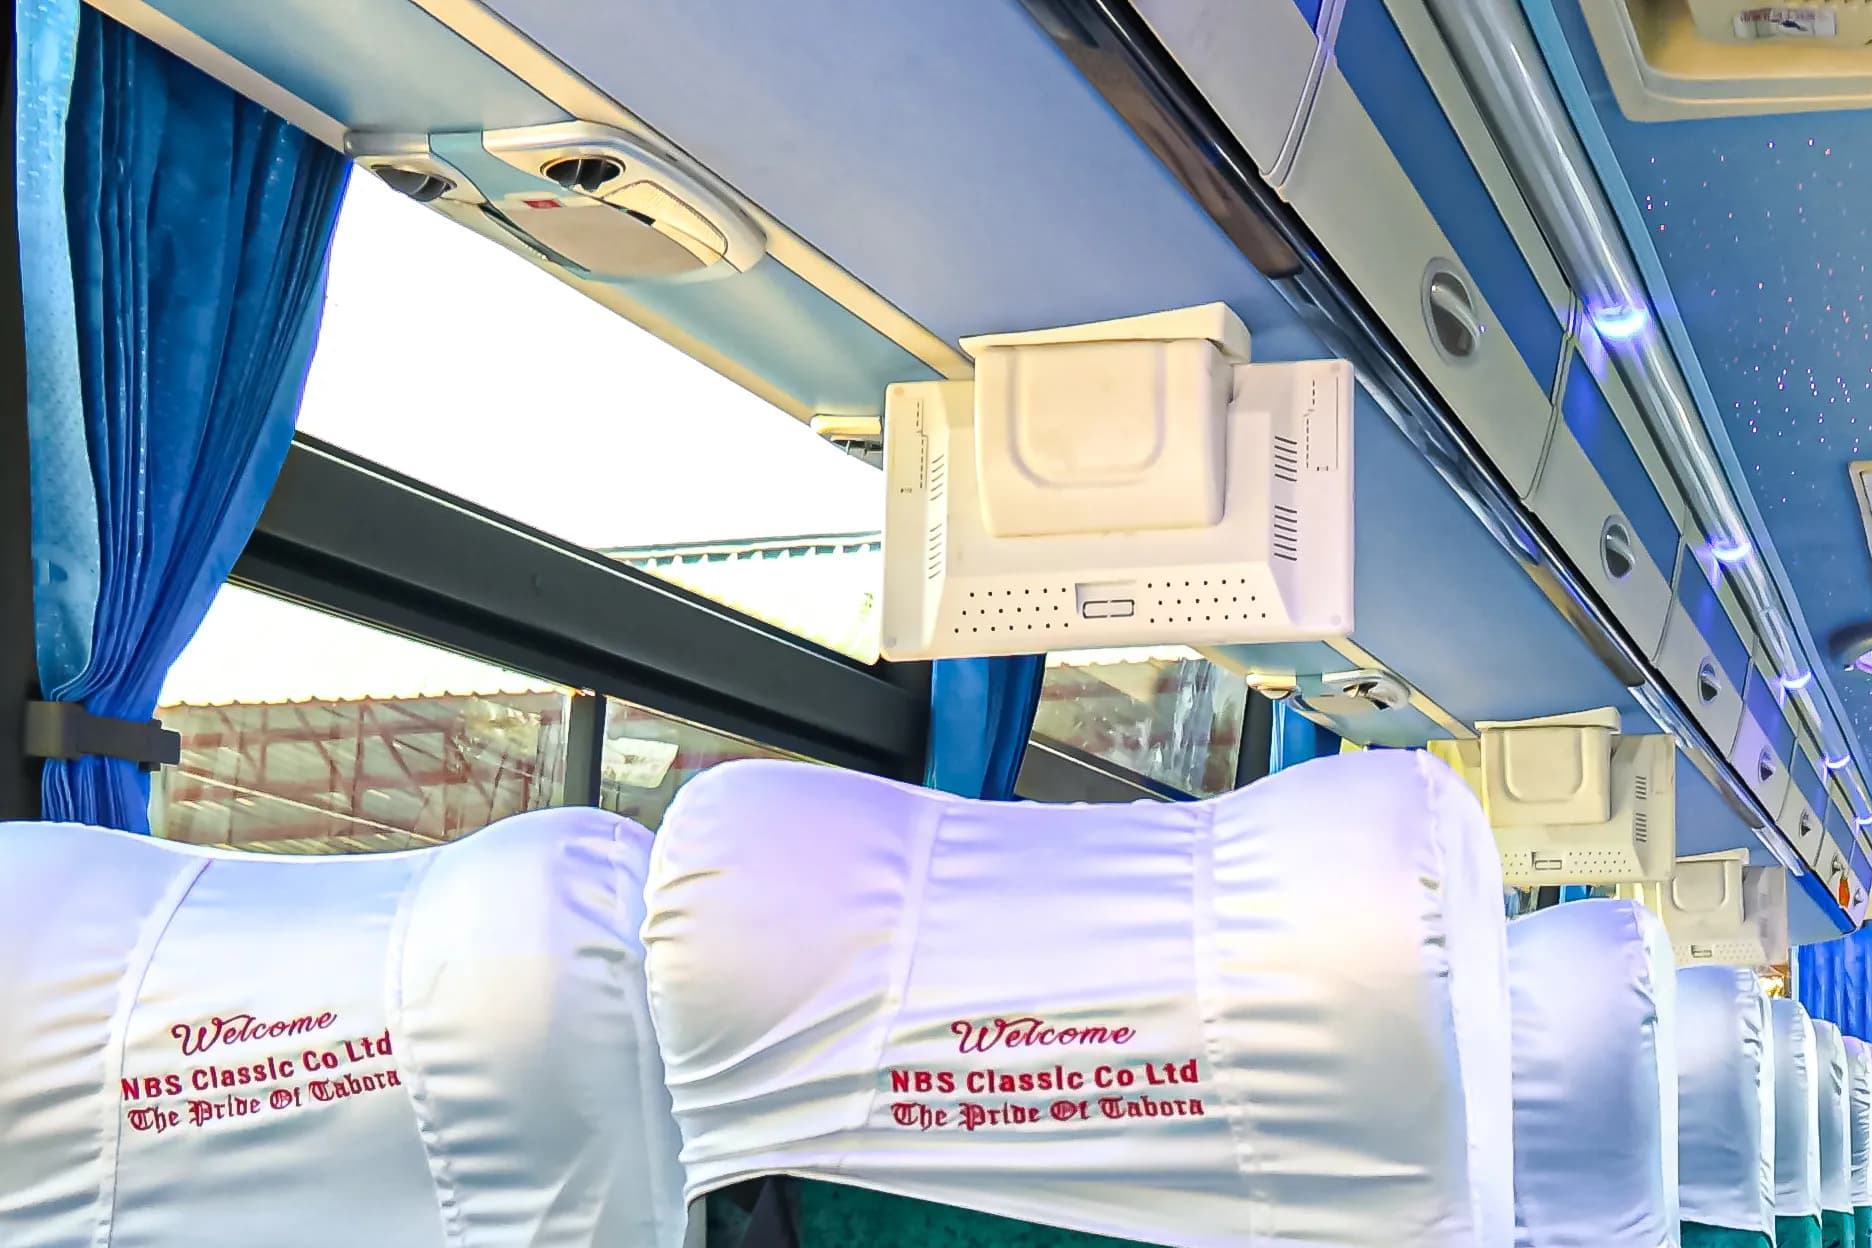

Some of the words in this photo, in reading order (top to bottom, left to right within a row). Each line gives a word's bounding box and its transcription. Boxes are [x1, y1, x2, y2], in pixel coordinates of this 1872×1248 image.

[171, 1011, 337, 1056] Welcome
[951, 1017, 1136, 1053] Welcome
[121, 1074, 183, 1101] NBS
[192, 1056, 294, 1091] Classic
[302, 1050, 338, 1072] Co
[344, 1028, 393, 1063] Ltd
[890, 1068, 955, 1094] NBS
[966, 1065, 1084, 1094] Classic
[1094, 1065, 1134, 1088] Co
[1145, 1058, 1199, 1085] Ltd
[128, 1105, 180, 1134] The
[188, 1094, 261, 1127] Pride
[269, 1087, 301, 1110] Of
[308, 1069, 401, 1101] Tabora
[891, 1101, 947, 1131] The
[958, 1101, 1041, 1131] Pride
[1050, 1099, 1089, 1121] Of
[1098, 1095, 1205, 1119] Tabora
